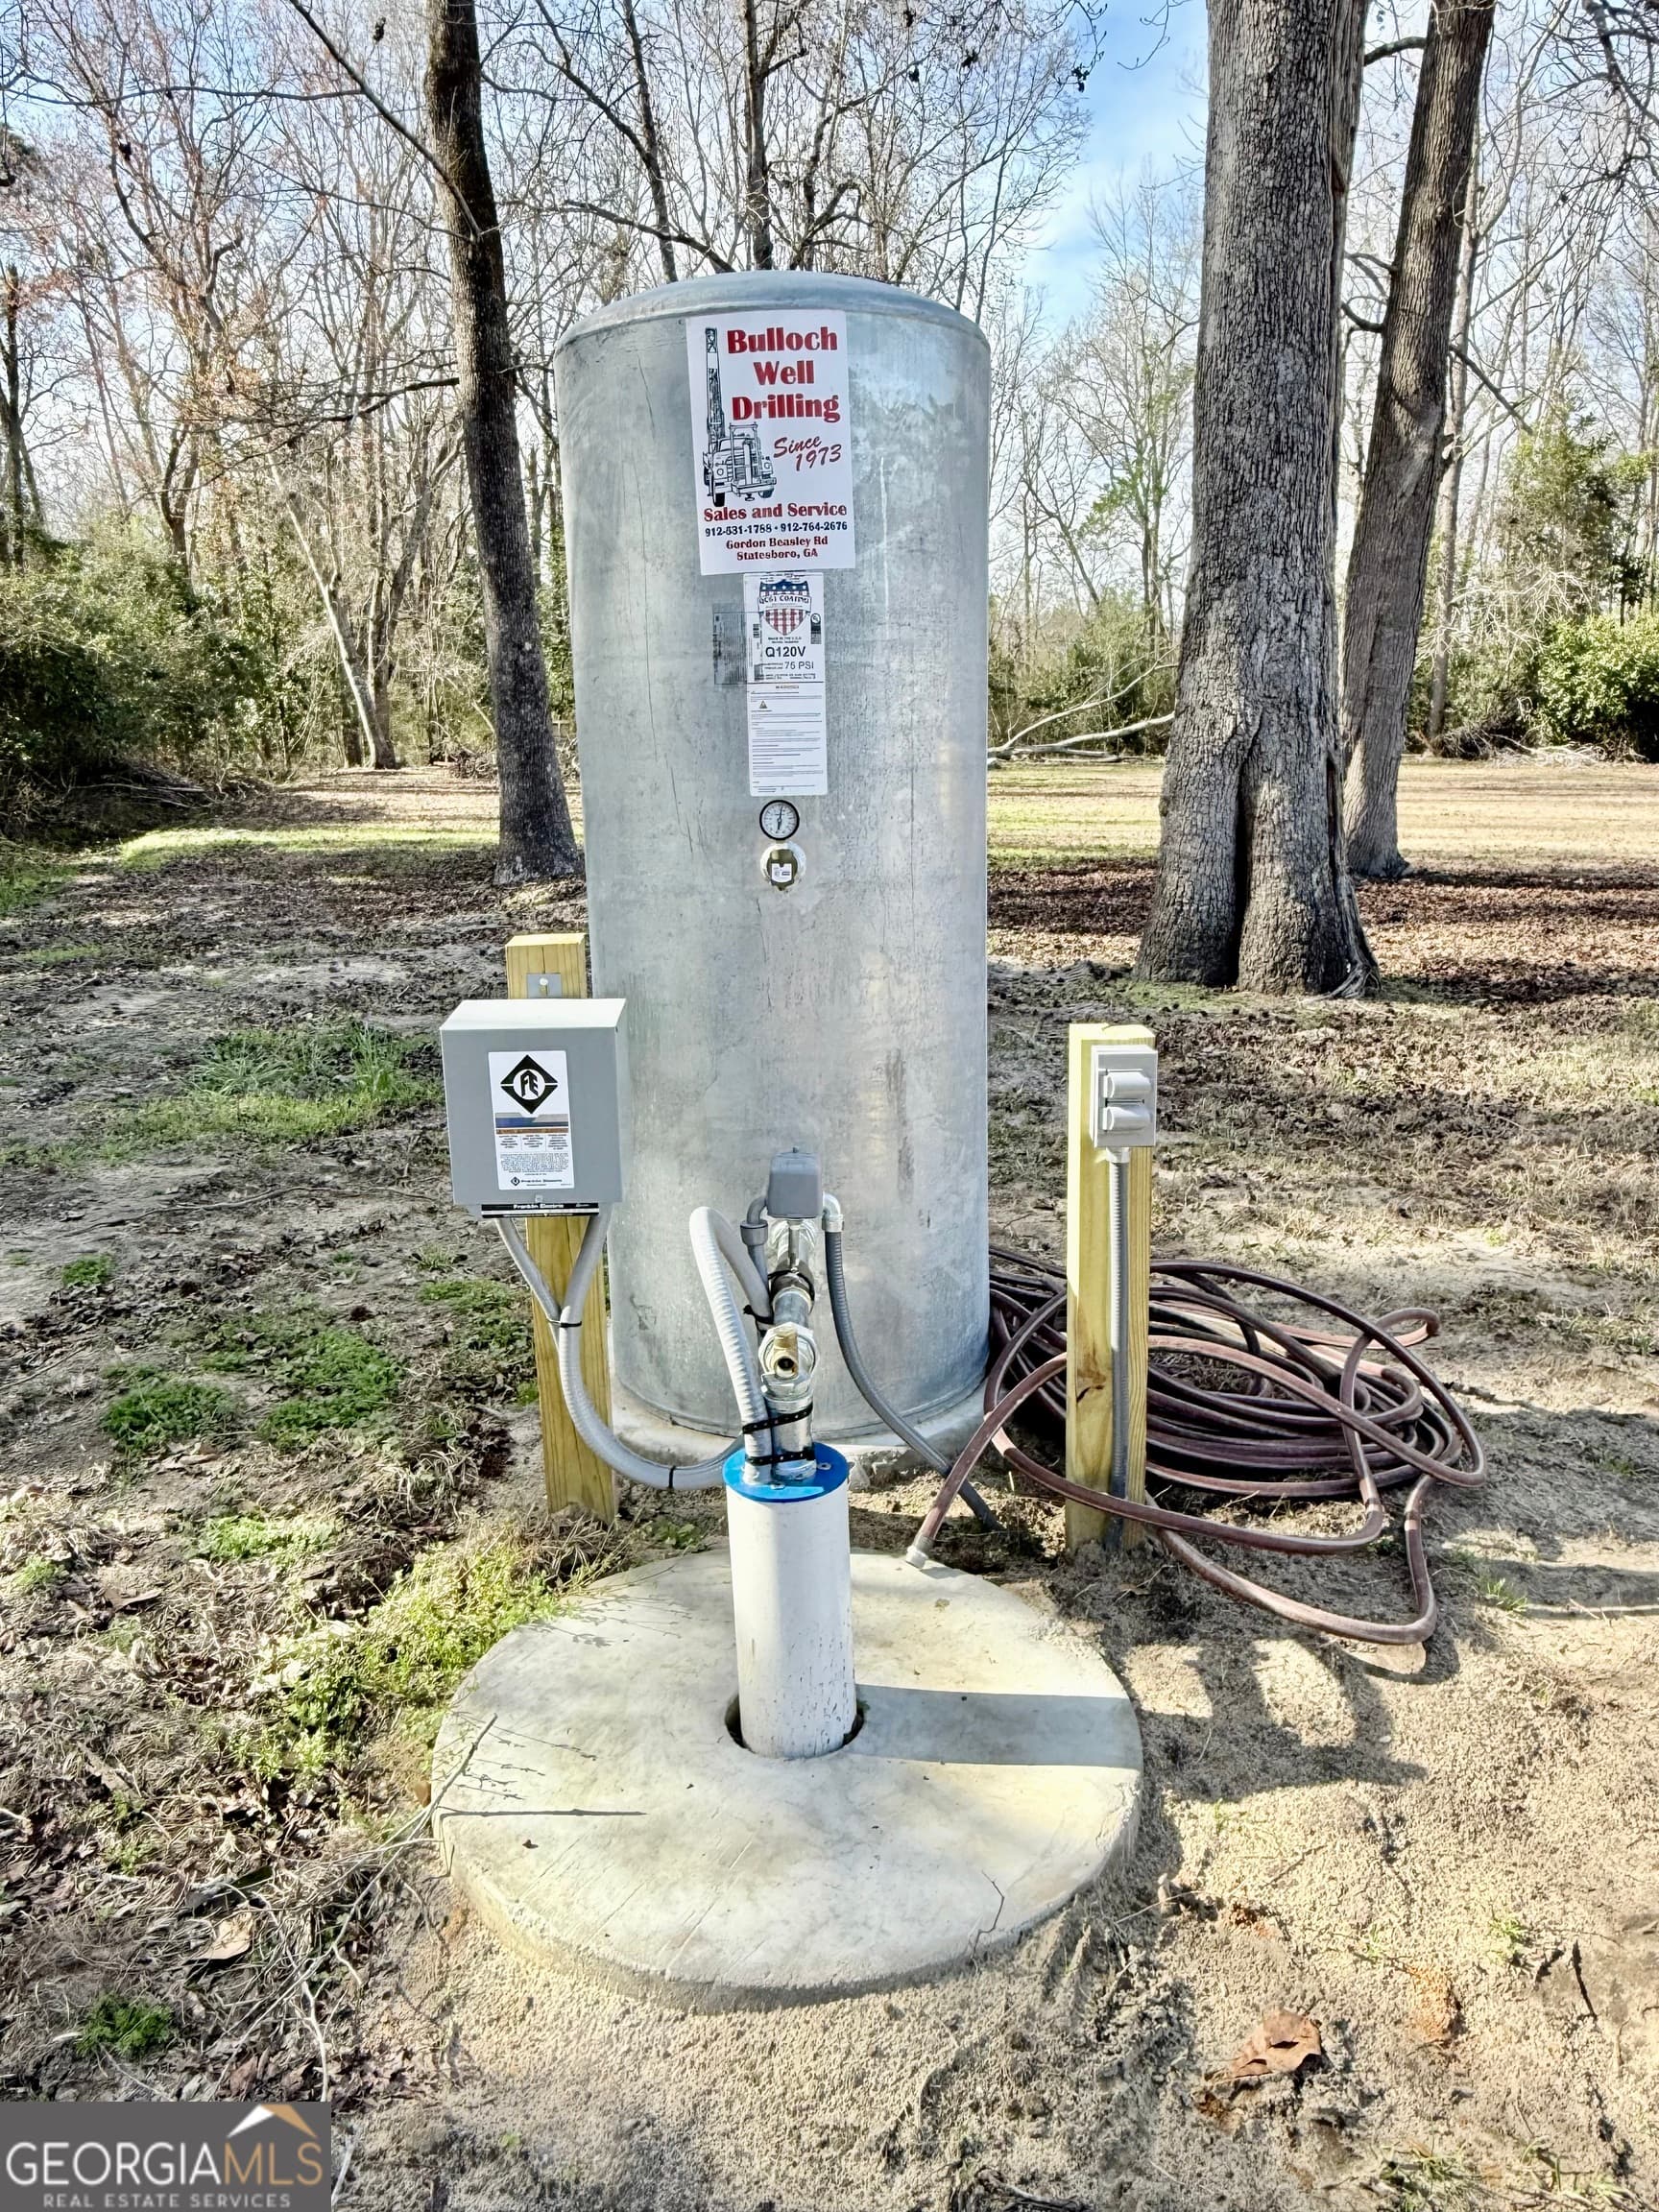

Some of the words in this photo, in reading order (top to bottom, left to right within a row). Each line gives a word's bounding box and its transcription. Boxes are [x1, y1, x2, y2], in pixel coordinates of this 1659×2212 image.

[727, 326, 838, 353] Bulloch
[753, 360, 815, 385] Well
[732, 393, 841, 422] Drilling
[773, 436, 823, 458] Since
[795, 444, 842, 471] 1973
[704, 507, 747, 522] Sales
[752, 503, 782, 518] and
[787, 502, 848, 517] Service
[781, 520, 848, 533] 912-764-2676
[726, 539, 766, 549] Gordon
[769, 536, 811, 548] Beasley
[813, 536, 829, 545] Rd
[736, 549, 801, 561] Statesboro,
[804, 548, 818, 558] GA
[765, 645, 806, 658] Q120V
[784, 661, 796, 669] 75
[798, 661, 814, 669] PSI
